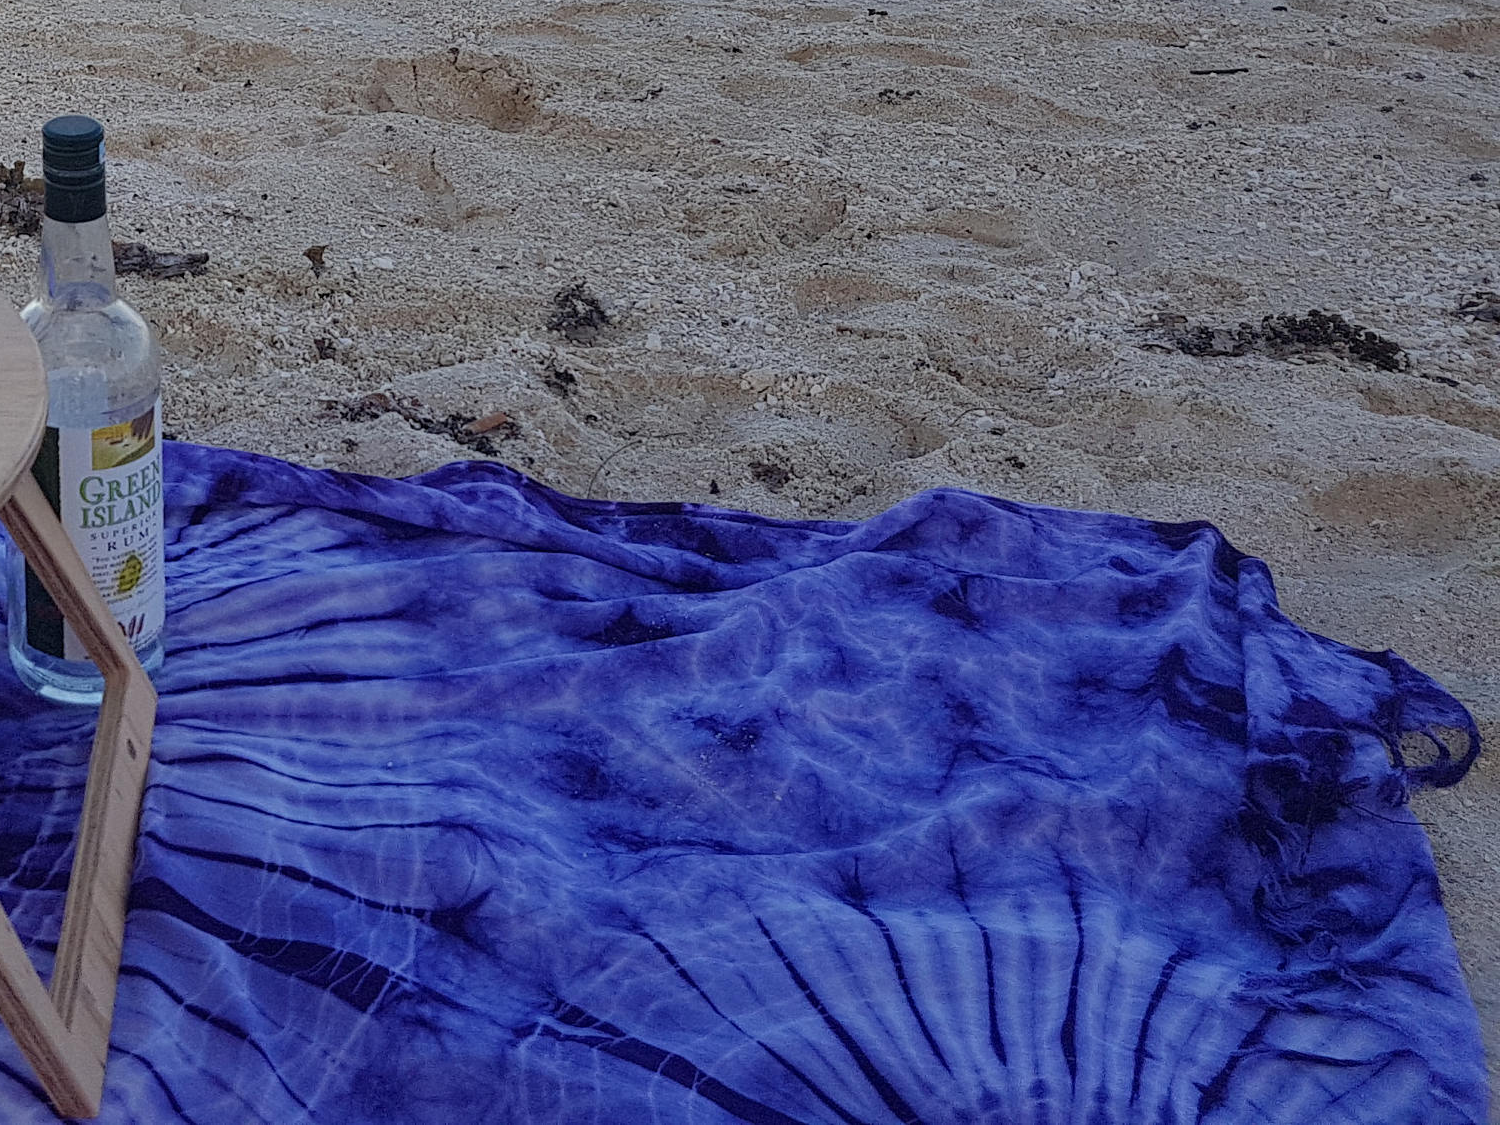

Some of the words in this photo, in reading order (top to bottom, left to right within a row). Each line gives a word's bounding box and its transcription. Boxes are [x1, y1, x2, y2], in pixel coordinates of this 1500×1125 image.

[79, 455, 160, 506] GREEN
[79, 480, 161, 529] ISLAND
[89, 510, 157, 542] SUPERIOR
[107, 527, 150, 552] RUM
